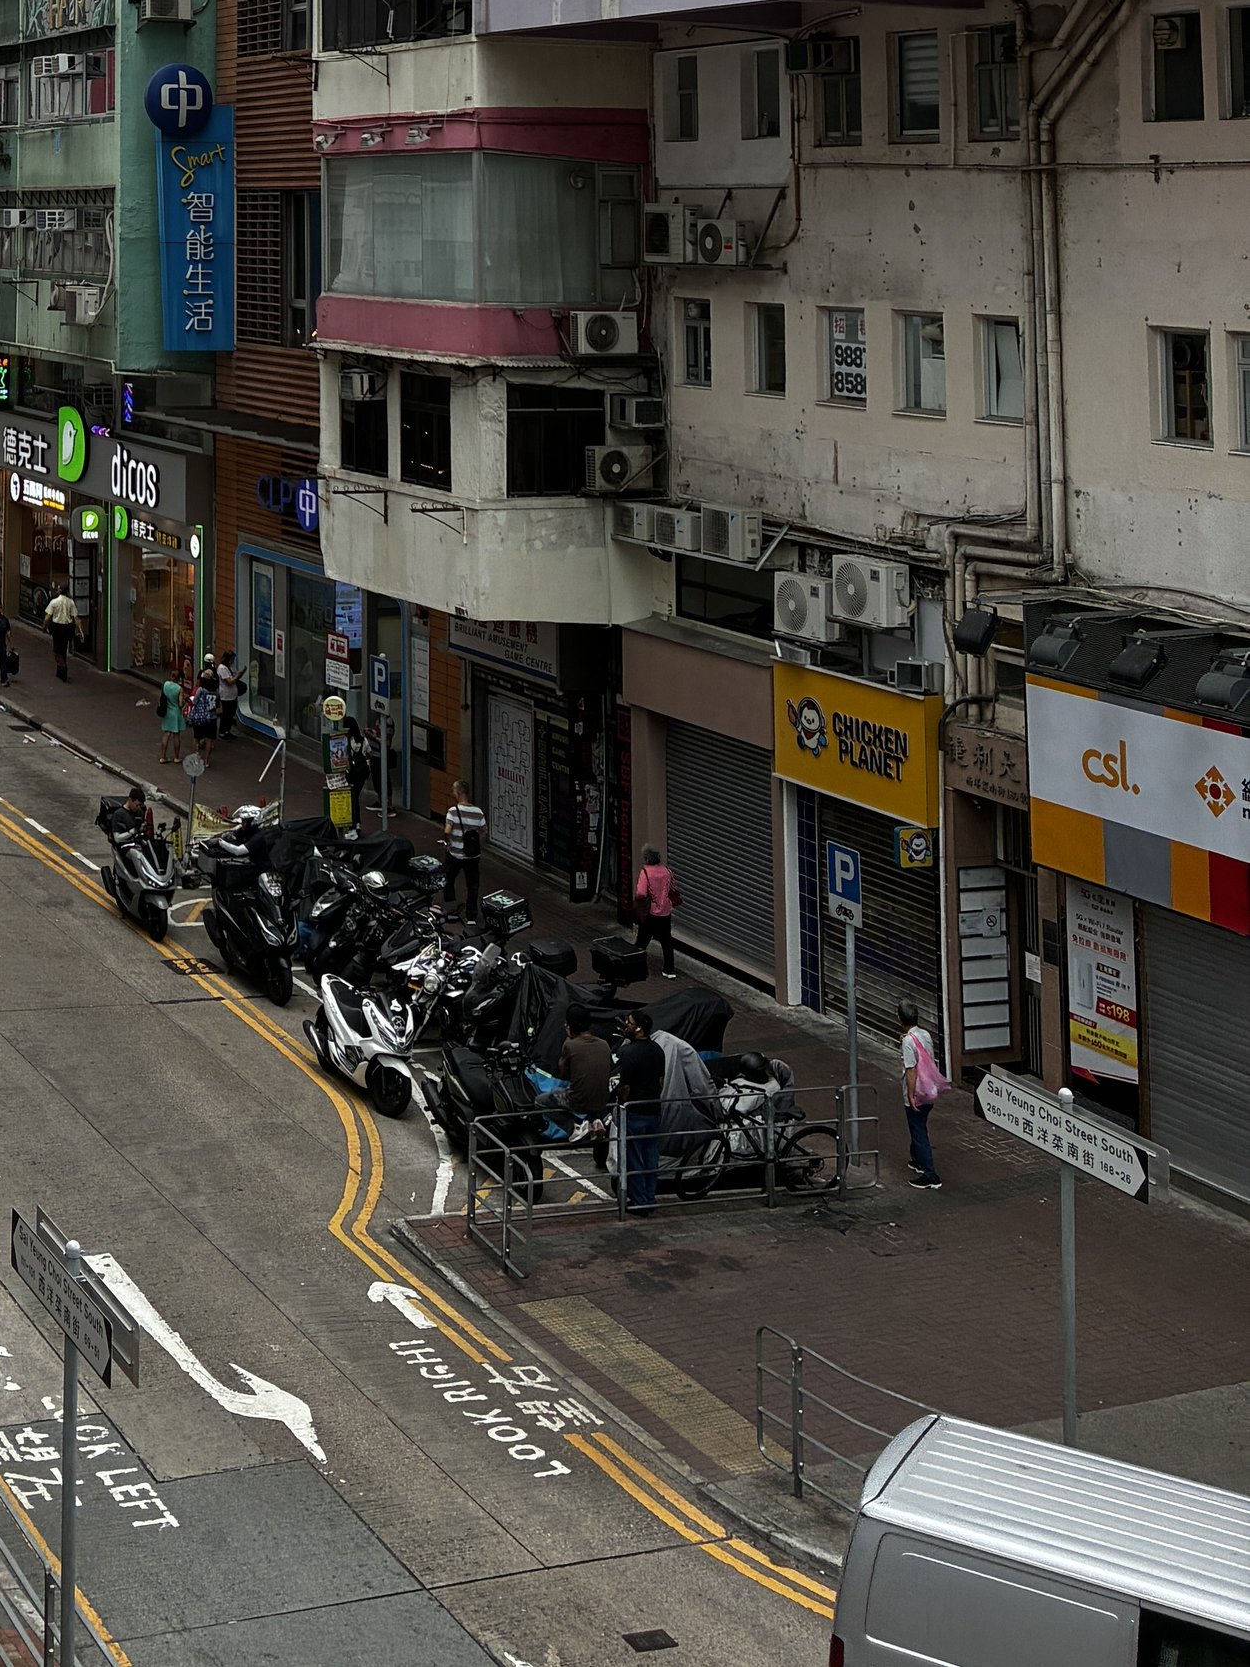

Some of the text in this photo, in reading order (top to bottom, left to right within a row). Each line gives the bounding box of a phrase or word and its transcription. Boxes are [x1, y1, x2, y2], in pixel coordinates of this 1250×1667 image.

[171, 143, 227, 188] Smart
[181, 191, 215, 332] 智能生活
[835, 371, 867, 395] 858
[3, 426, 48, 474] 德克士
[111, 443, 157, 508] dicos
[256, 474, 292, 513] CLP
[454, 622, 529, 653] BRILLIANT AMUSEMENT
[374, 661, 386, 692] P
[504, 649, 553, 674] GAME CENTRE
[832, 711, 908, 758] CHICKEN
[838, 737, 904, 782] PLANET
[835, 850, 854, 893] P
[987, 1080, 1134, 1164] Sai Yeung Choi Street South
[1022, 1117, 1094, 1169] 西洋菜南街
[19, 1224, 103, 1337] Sai Yeung Choi Street South
[462, 1408, 574, 1478] LOOK
[95, 1467, 180, 1528] LEFT
